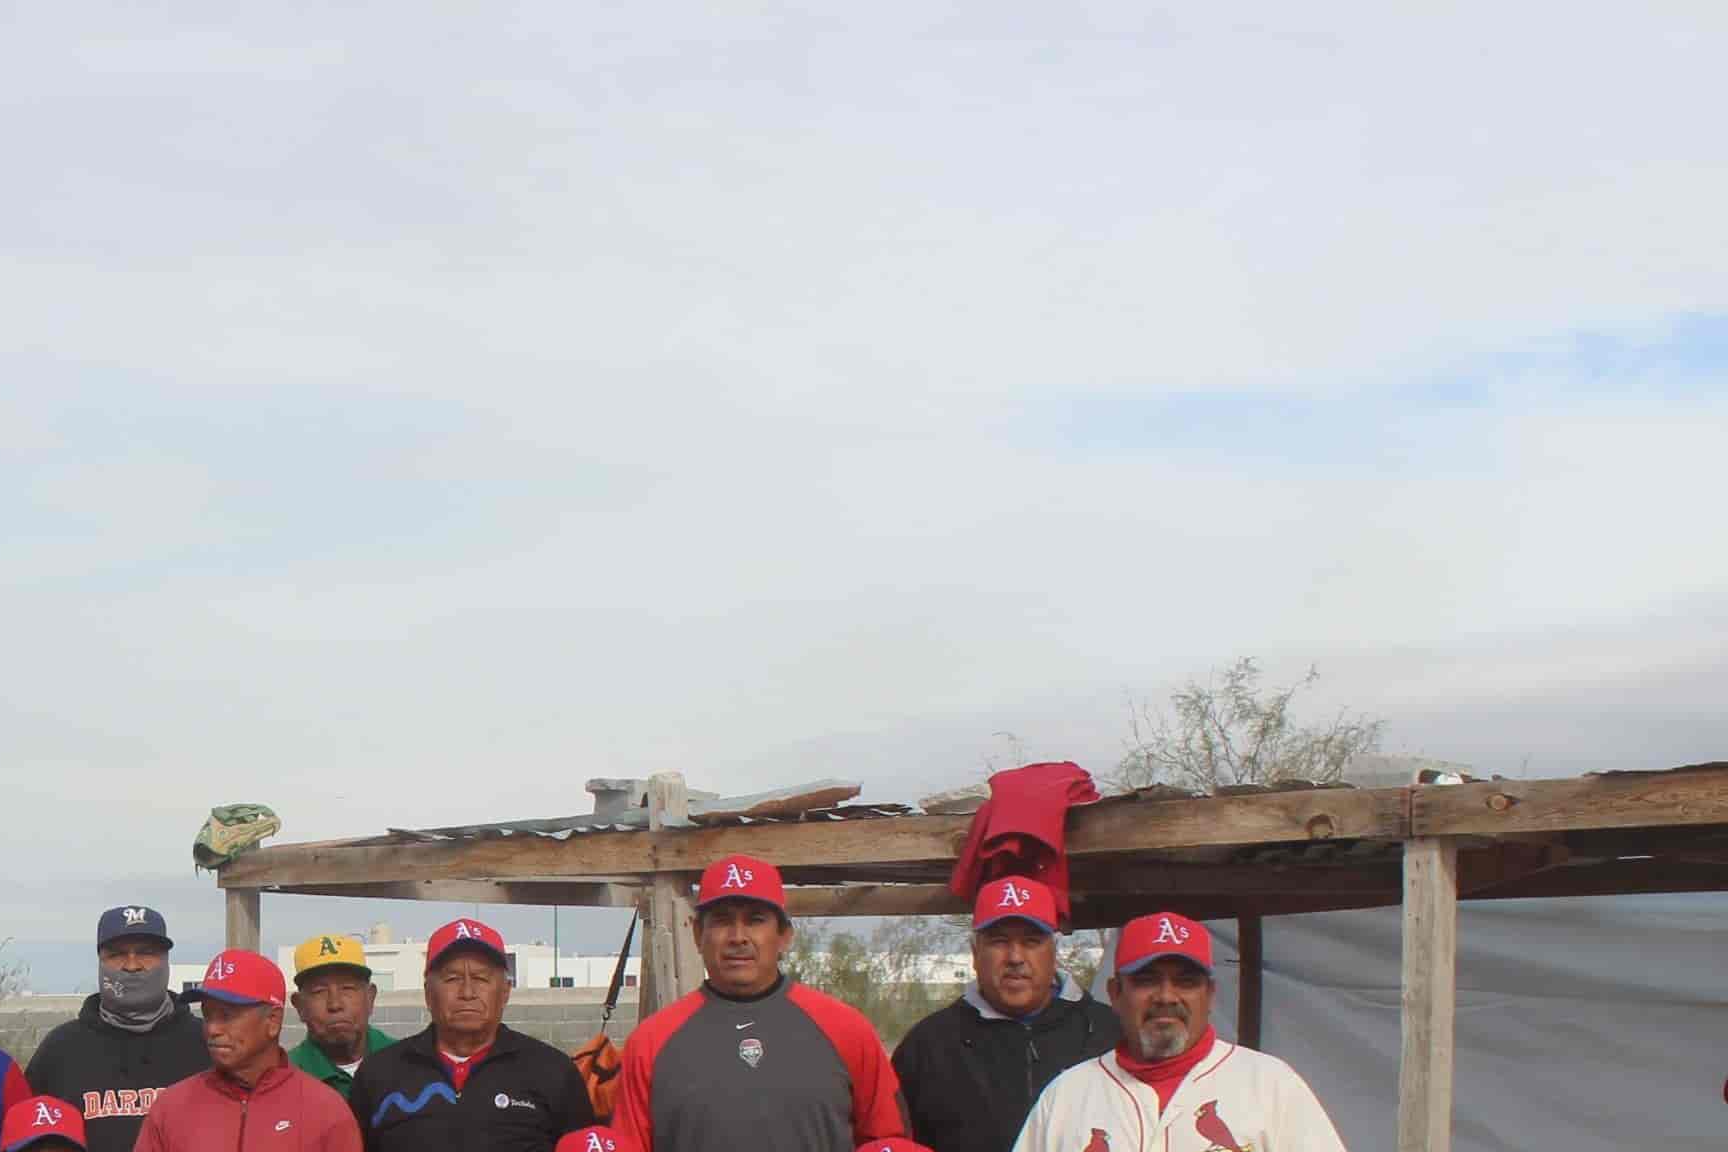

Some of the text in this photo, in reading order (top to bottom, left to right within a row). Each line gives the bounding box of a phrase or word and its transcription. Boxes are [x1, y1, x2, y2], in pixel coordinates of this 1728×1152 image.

[721, 864, 753, 887] A's
[999, 883, 1031, 906] A's
[1152, 918, 1189, 944] A's
[209, 956, 235, 980] A's
[32, 1102, 63, 1126] A's
[83, 1087, 167, 1119] DARD
